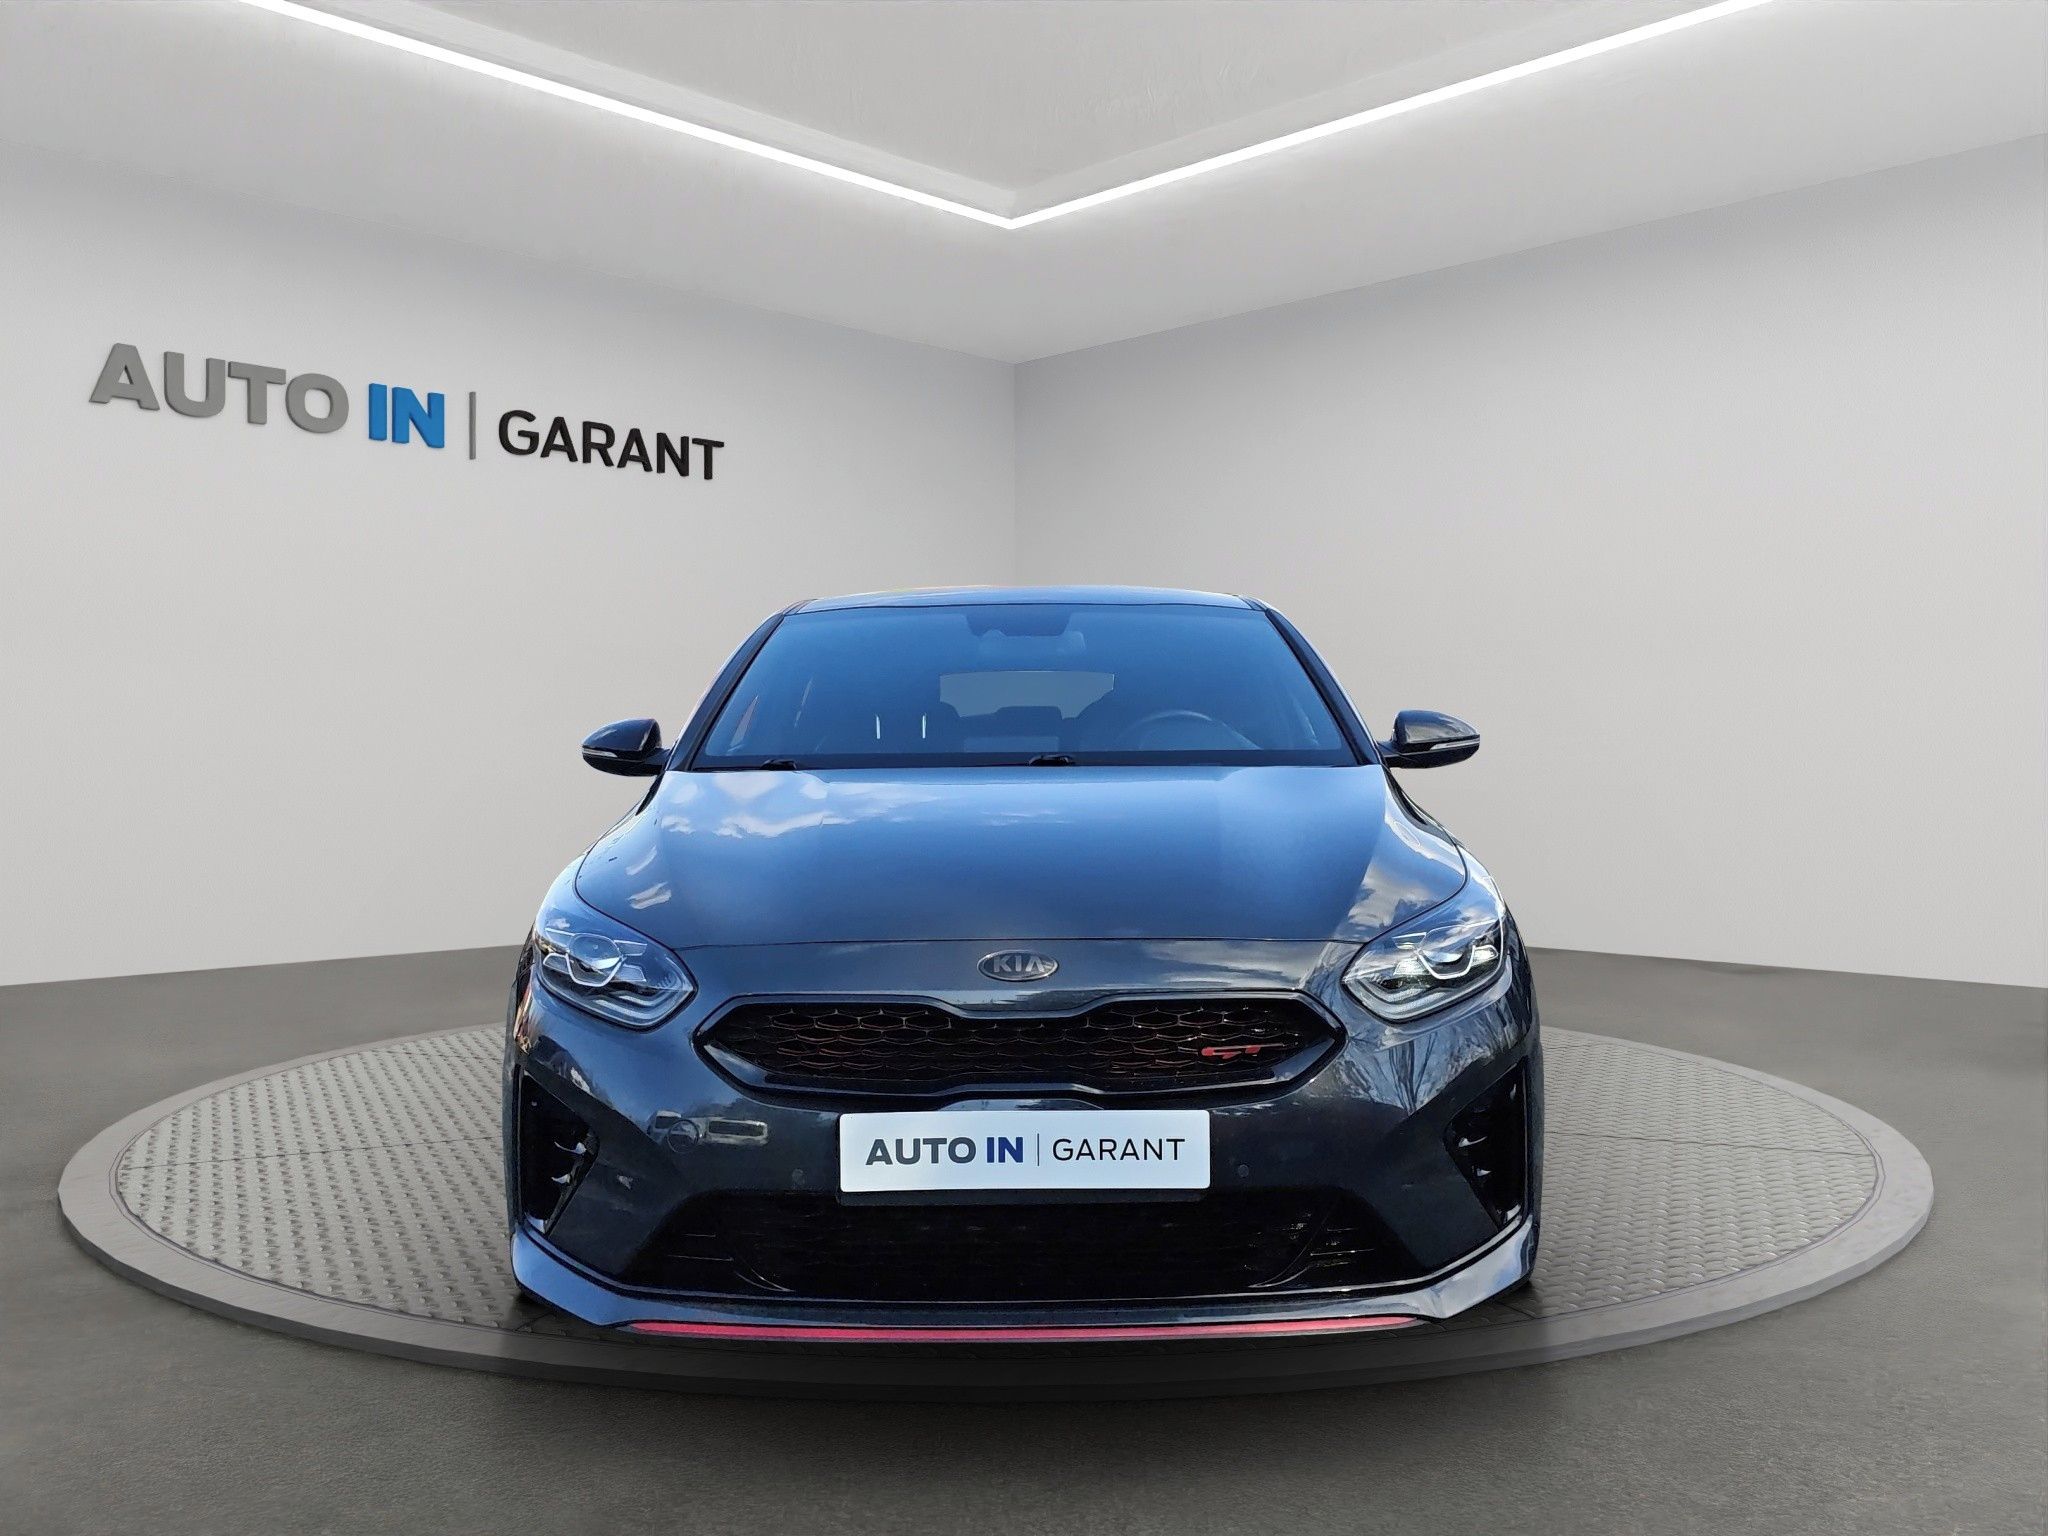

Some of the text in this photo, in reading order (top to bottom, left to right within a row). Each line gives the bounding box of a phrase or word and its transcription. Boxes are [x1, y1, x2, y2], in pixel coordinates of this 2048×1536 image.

[88, 342, 725, 480] AUTO IN GARANT
[993, 955, 1046, 973] KIA
[865, 1136, 1186, 1166] AUTO IN GARANT
